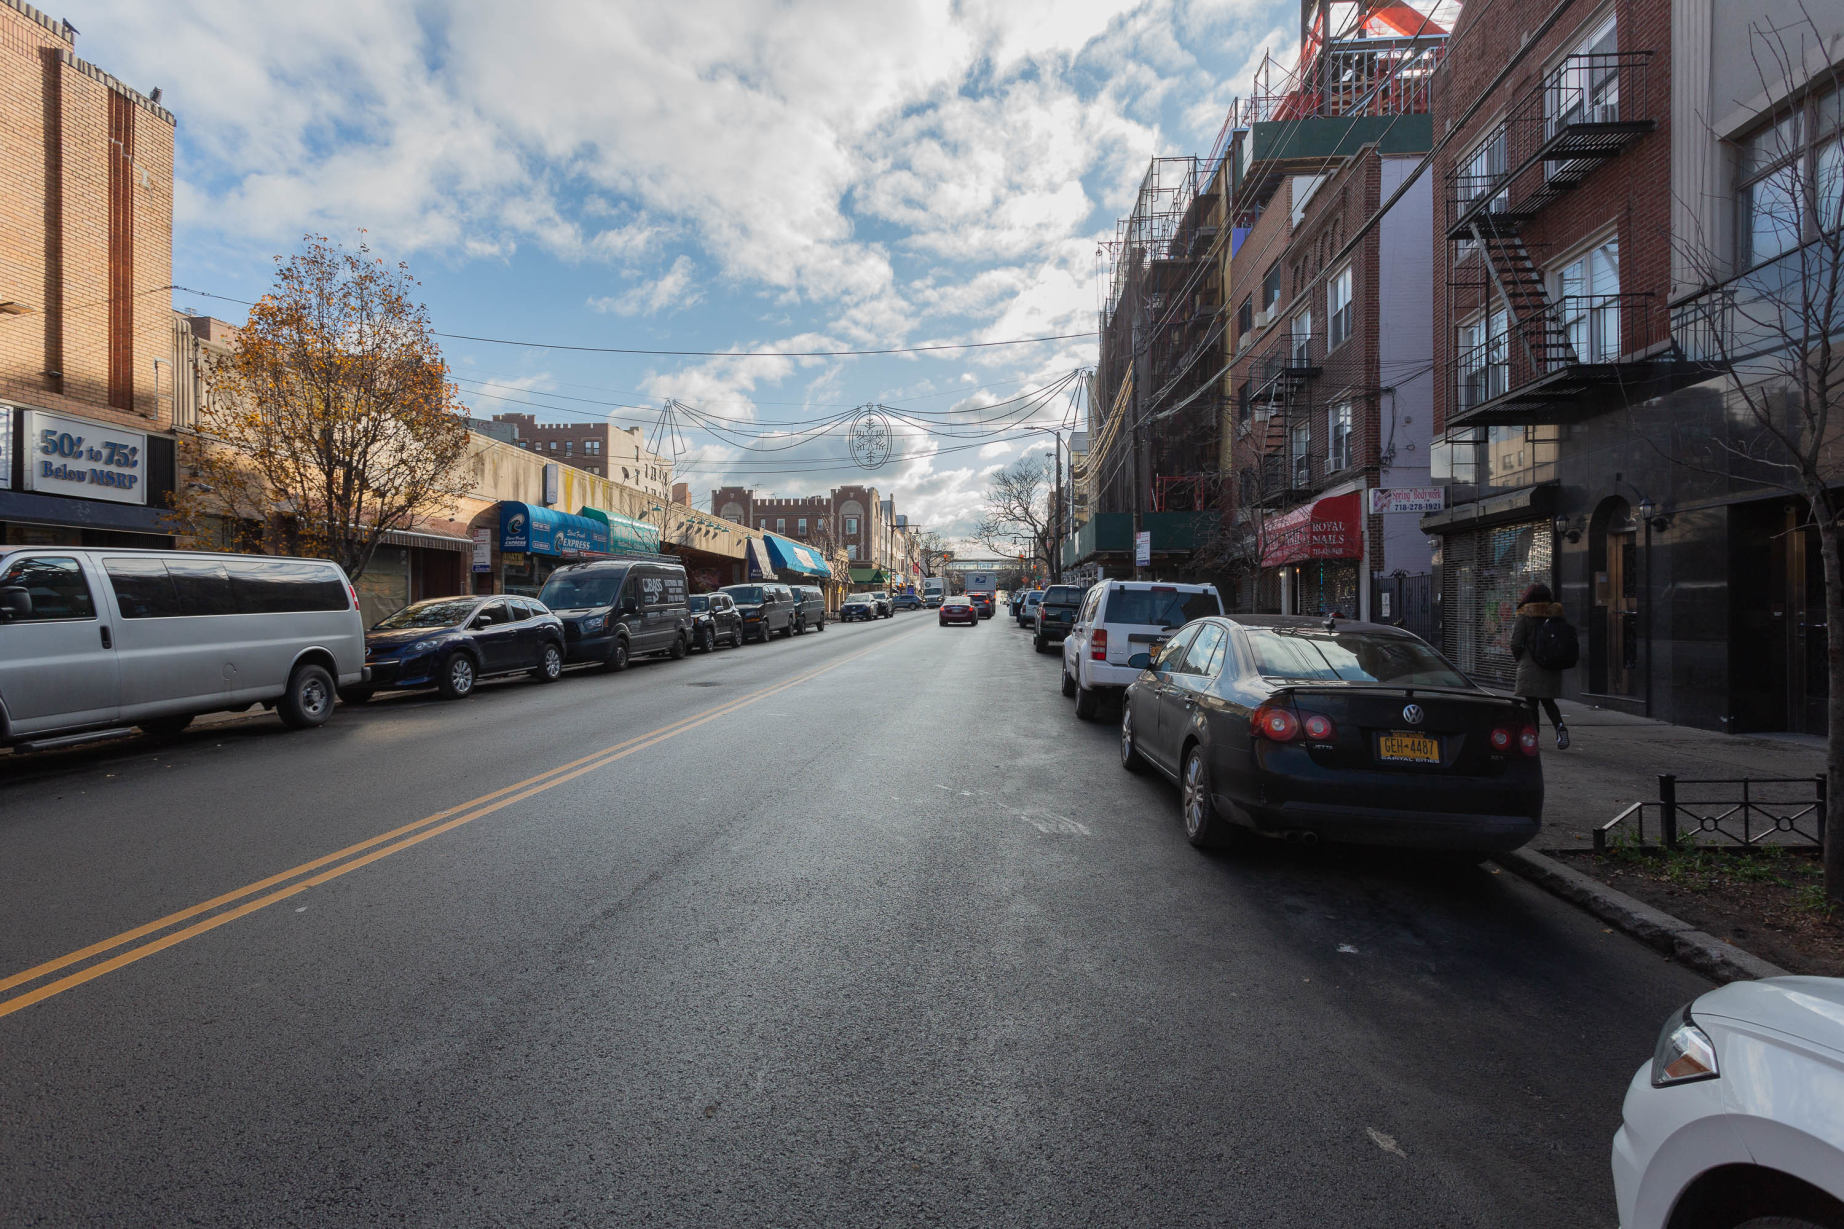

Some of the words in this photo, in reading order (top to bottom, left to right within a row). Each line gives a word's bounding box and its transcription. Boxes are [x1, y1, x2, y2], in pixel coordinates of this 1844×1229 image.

[40, 429, 85, 459] 50%
[88, 446, 103, 462] to
[104, 440, 140, 468] 75%
[41, 461, 87, 482] Below
[89, 468, 138, 489] MSRP
[1392, 489, 1411, 502] Spring
[1312, 521, 1345, 531] ROYAL
[562, 538, 591, 550] EXPRESS
[1312, 534, 1345, 544] NAILS
